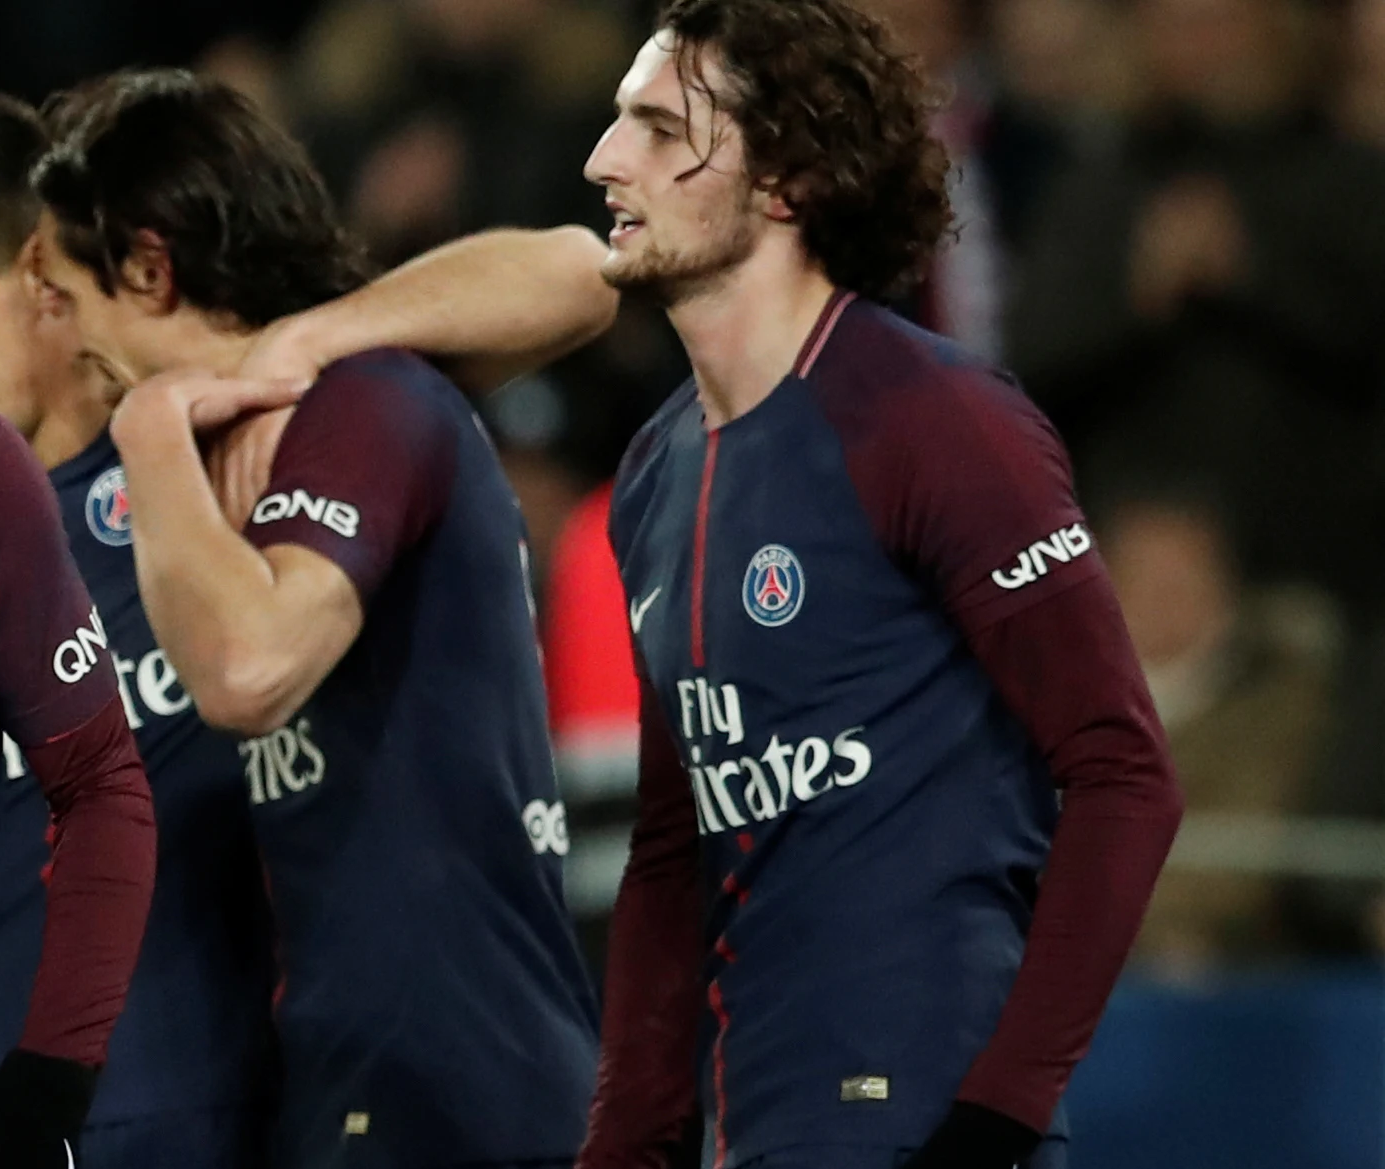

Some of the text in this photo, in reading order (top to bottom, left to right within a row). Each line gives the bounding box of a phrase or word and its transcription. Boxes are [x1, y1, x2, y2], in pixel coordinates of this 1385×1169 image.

[251, 488, 359, 538] QNB
[53, 604, 109, 684] QN
[677, 677, 745, 745] Fly
[686, 724, 873, 836] irates
